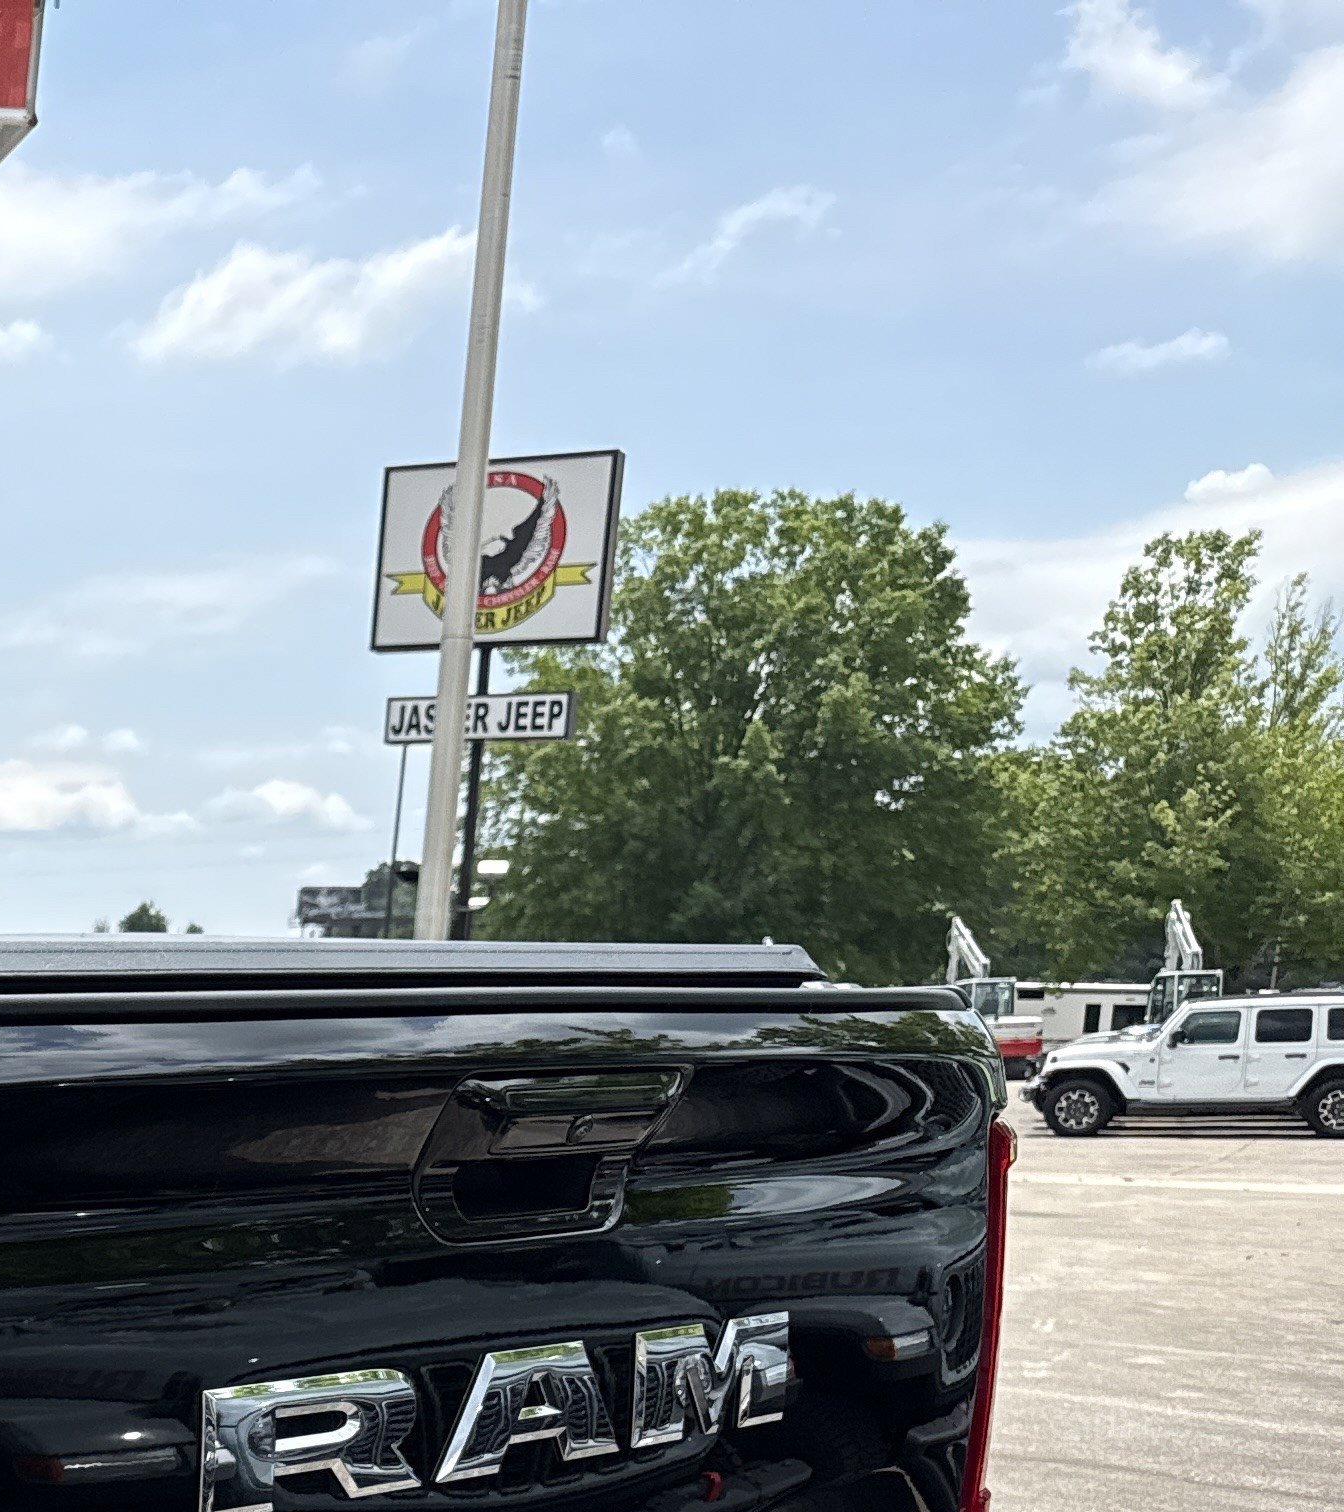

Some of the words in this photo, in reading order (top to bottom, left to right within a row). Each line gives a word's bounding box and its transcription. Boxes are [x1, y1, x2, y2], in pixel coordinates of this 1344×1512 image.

[492, 473, 519, 487] SA
[390, 702, 490, 736] JASR
[496, 700, 564, 733] JEEP
